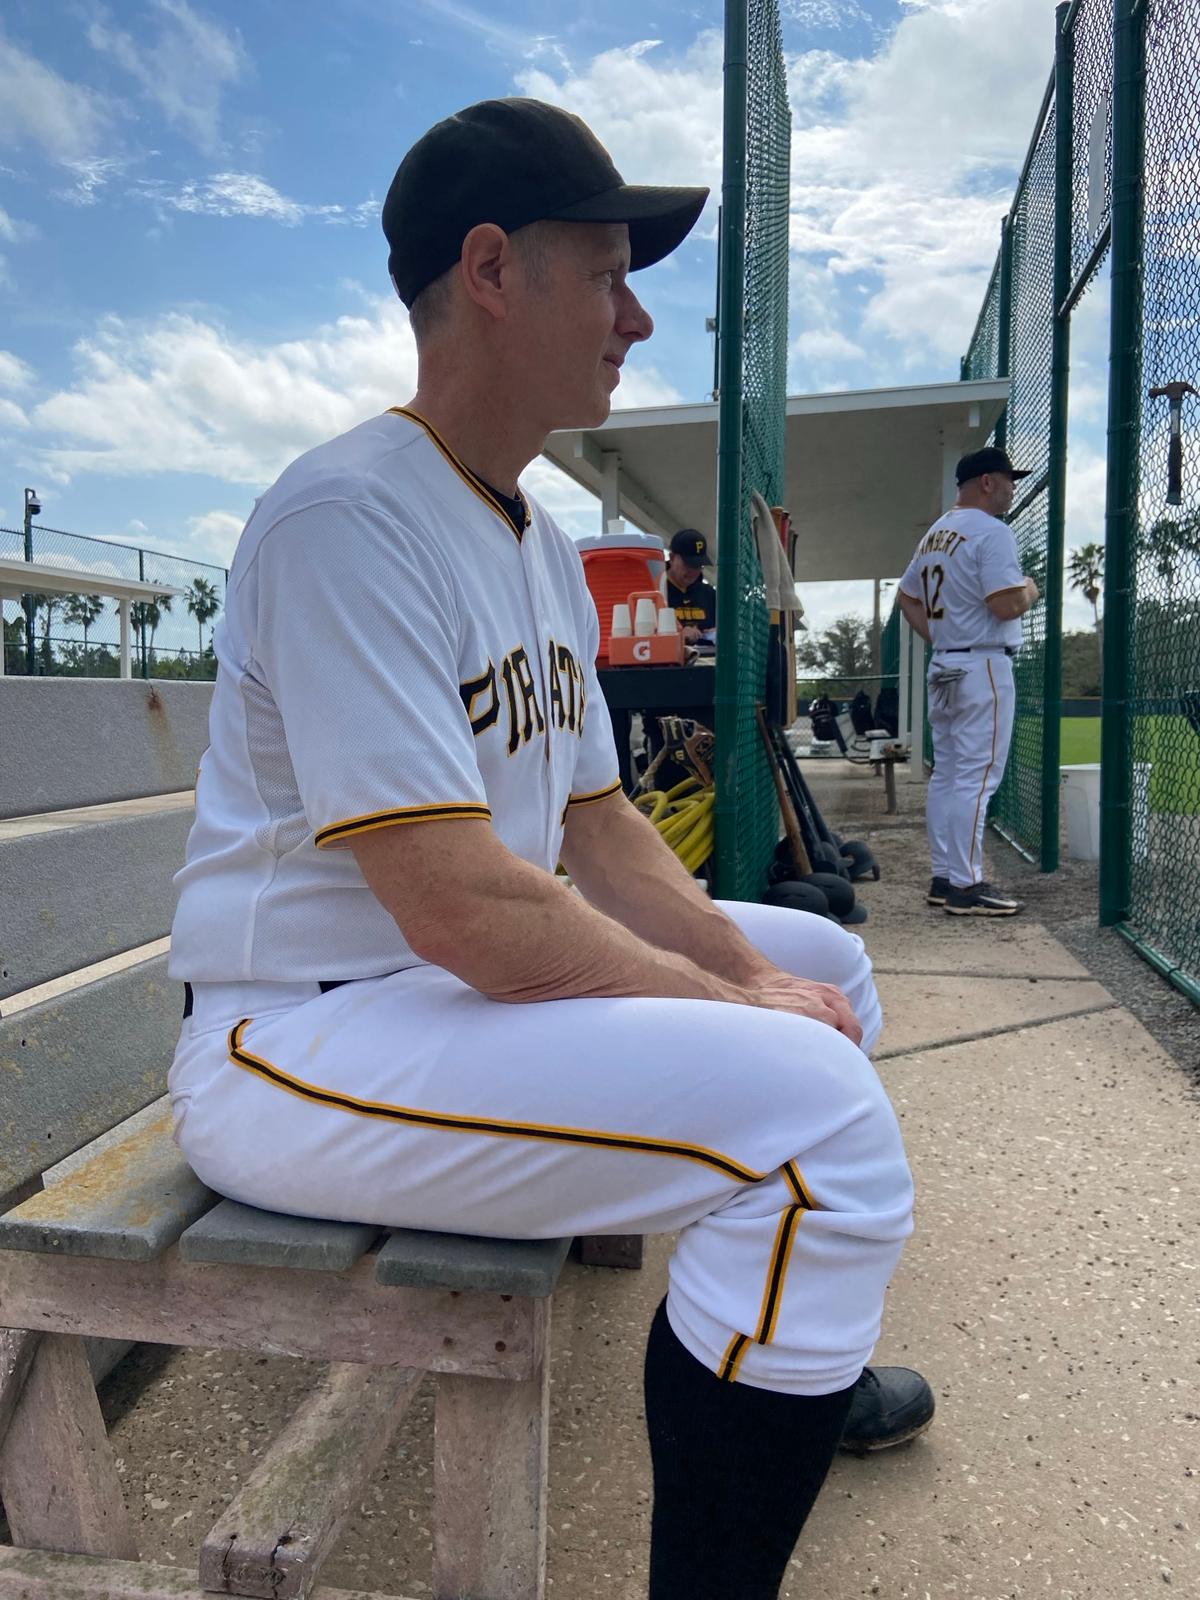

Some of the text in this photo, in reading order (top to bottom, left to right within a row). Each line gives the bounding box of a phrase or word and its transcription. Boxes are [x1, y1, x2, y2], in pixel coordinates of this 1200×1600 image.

[695, 541, 704, 553] P
[920, 564, 945, 619] 12
[632, 641, 650, 661] G
